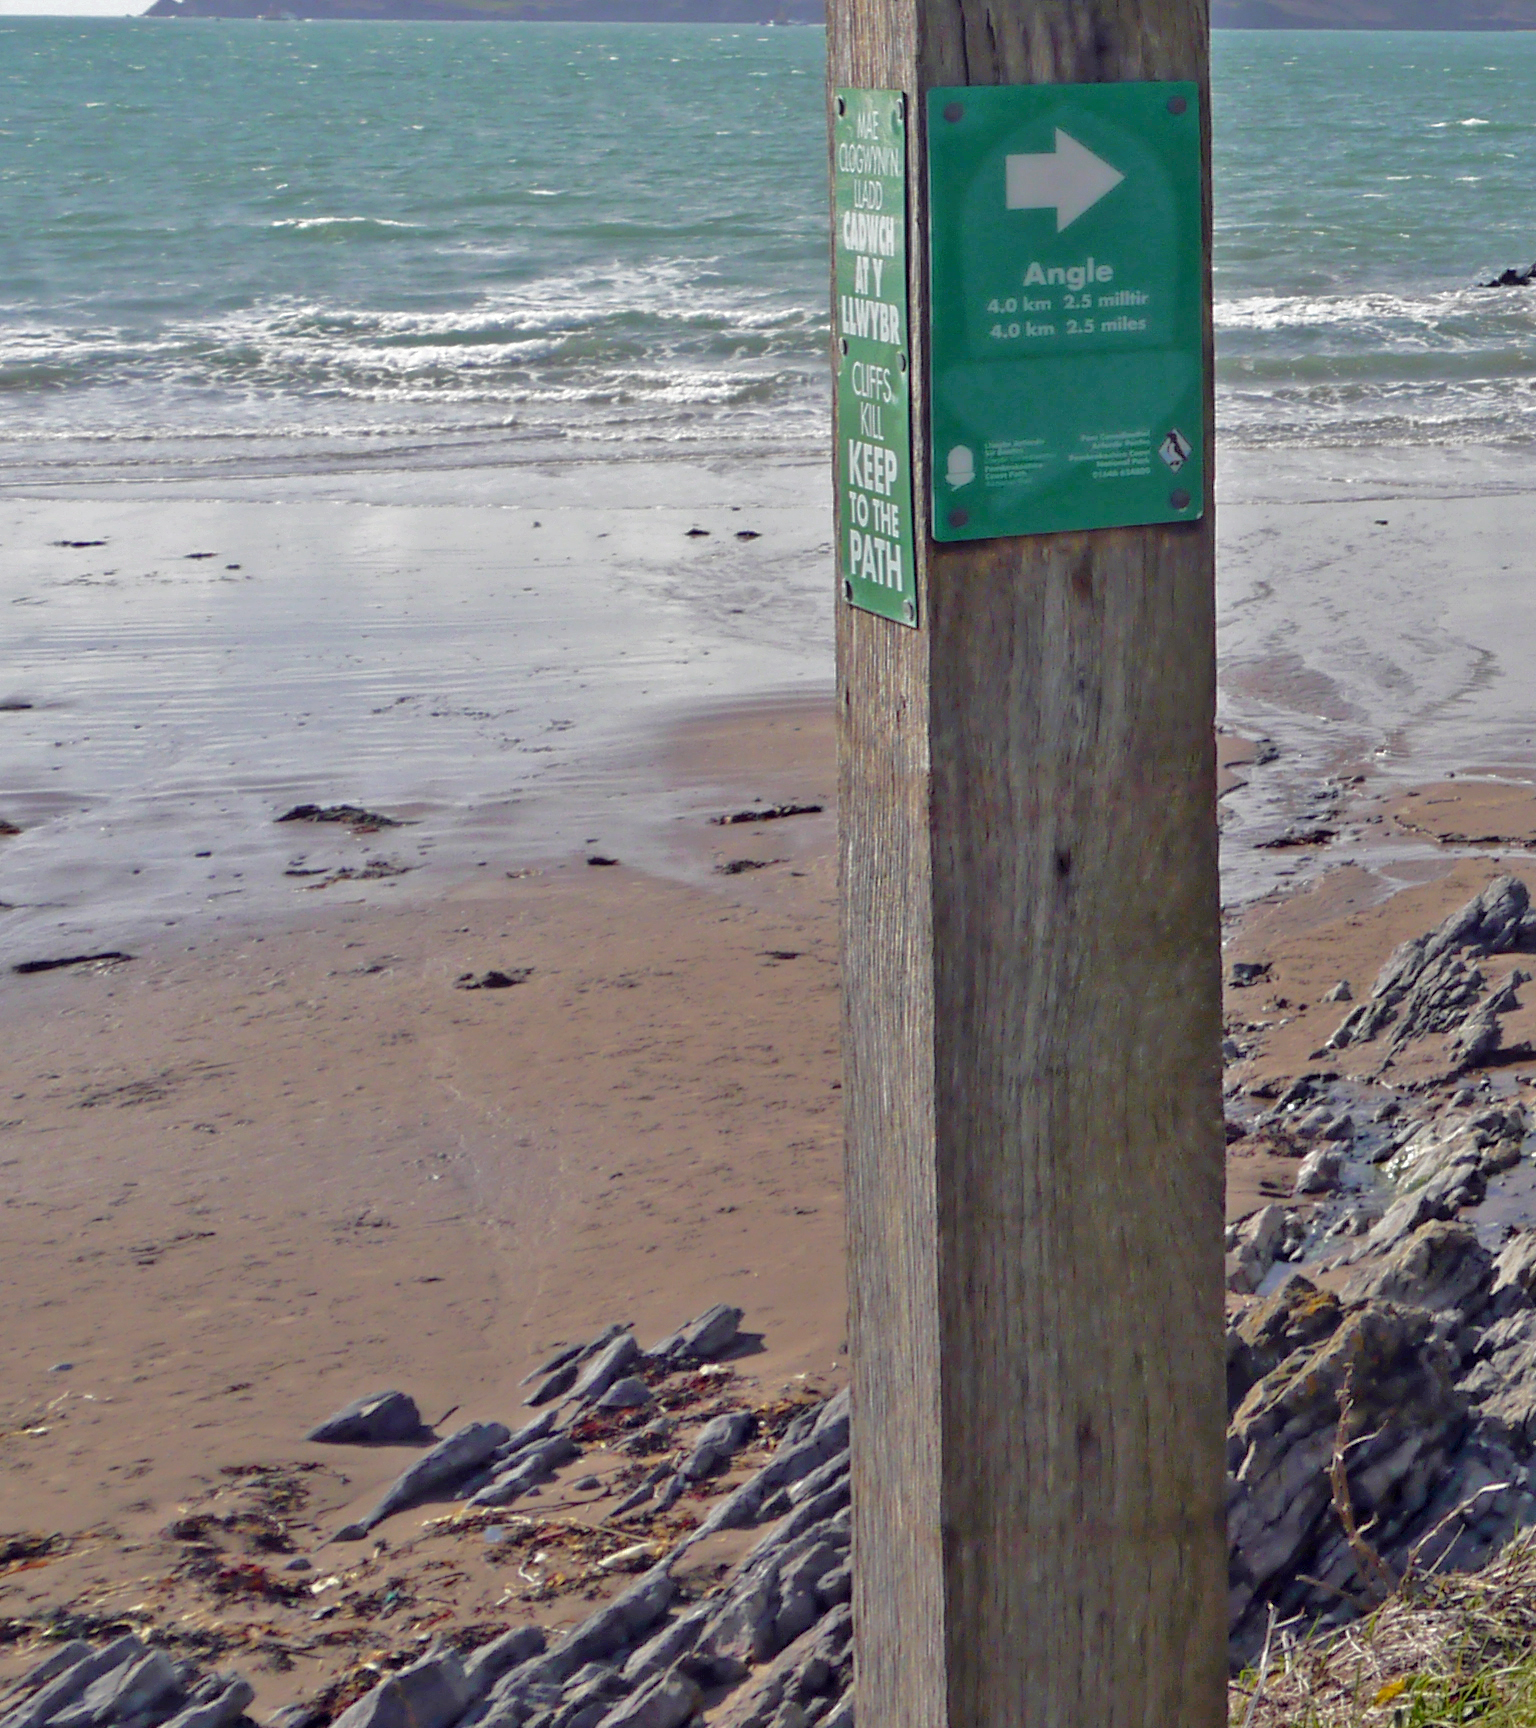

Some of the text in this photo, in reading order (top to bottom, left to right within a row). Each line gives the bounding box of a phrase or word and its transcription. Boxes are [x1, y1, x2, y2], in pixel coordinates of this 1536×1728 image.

[856, 110, 880, 141] MAE
[853, 179, 884, 211] LLADD
[842, 210, 896, 258] CADWCH
[854, 255, 884, 298] AT Y
[1022, 257, 1114, 292] Angle
[841, 295, 902, 346] LLWYBR
[986, 290, 1150, 314] 4.0 km 2.5 milltir
[989, 315, 1147, 339] 4.0 km 2.5 miles
[851, 361, 892, 404] CLIFFS
[859, 401, 885, 441] KILL
[848, 438, 898, 497] KEEP
[848, 490, 900, 539] TO THE
[850, 528, 903, 593] PATH
